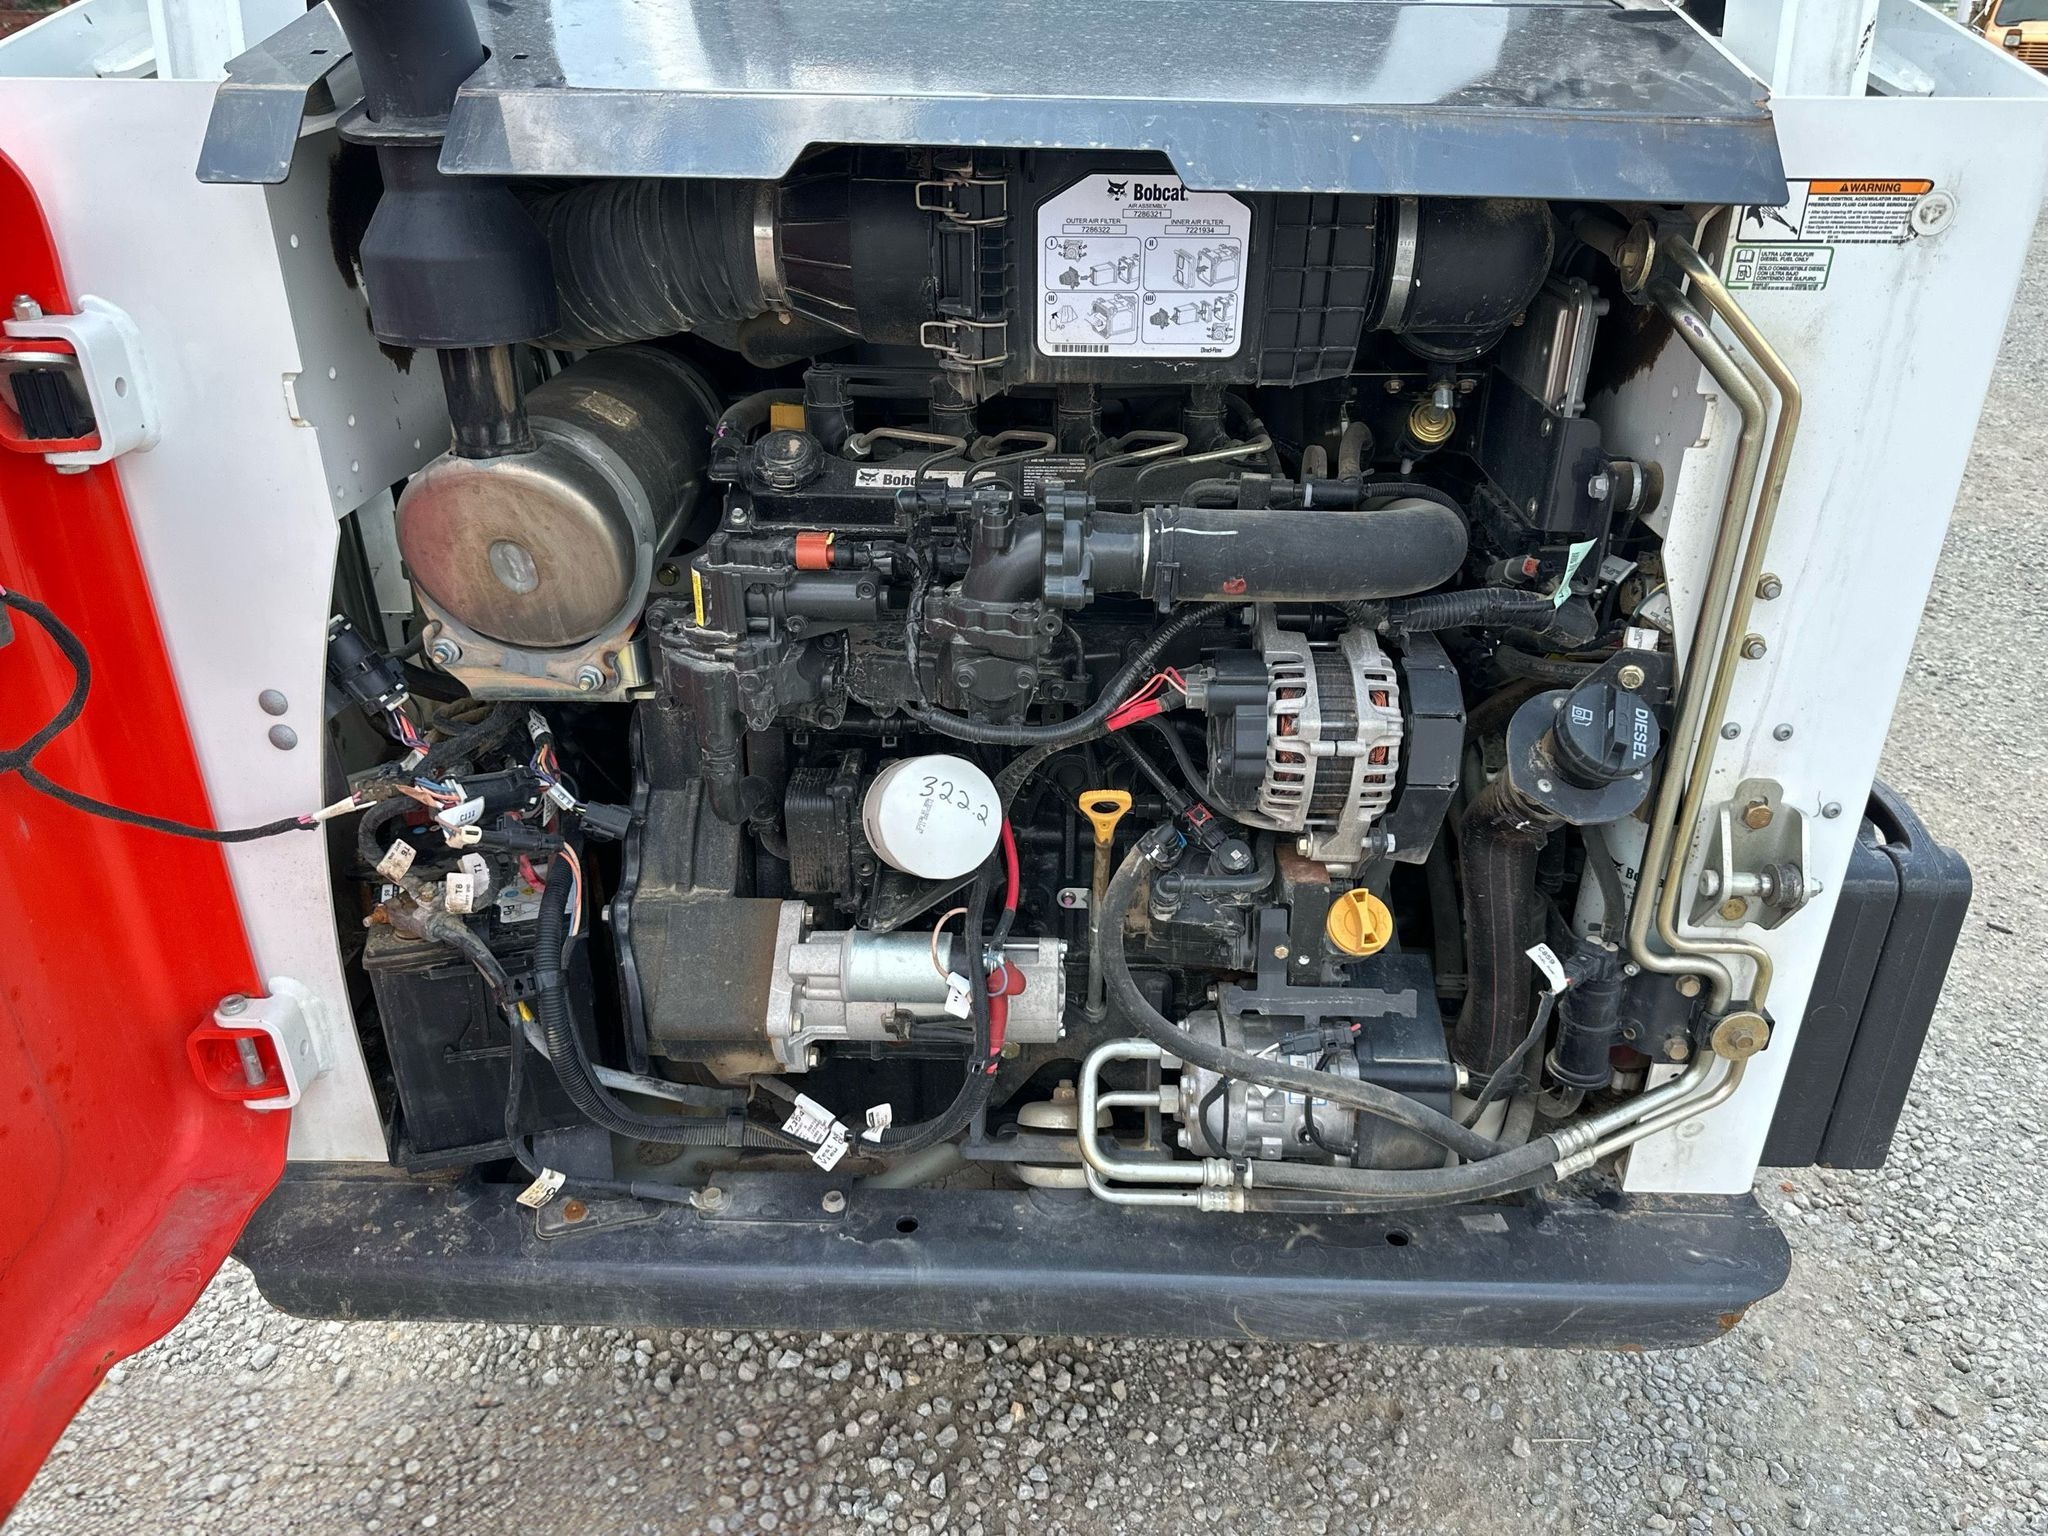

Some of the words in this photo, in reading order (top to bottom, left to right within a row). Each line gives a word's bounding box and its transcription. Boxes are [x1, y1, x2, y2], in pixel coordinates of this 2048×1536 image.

[1134, 183, 1186, 202] Bobcat
[1849, 183, 1902, 193] WARNING
[1133, 210, 1163, 218] 7286321
[1081, 226, 1111, 234] 7286322
[1632, 707, 1649, 760] DIESEL
[919, 776, 989, 827] 322.2
[455, 883, 464, 895] T8
